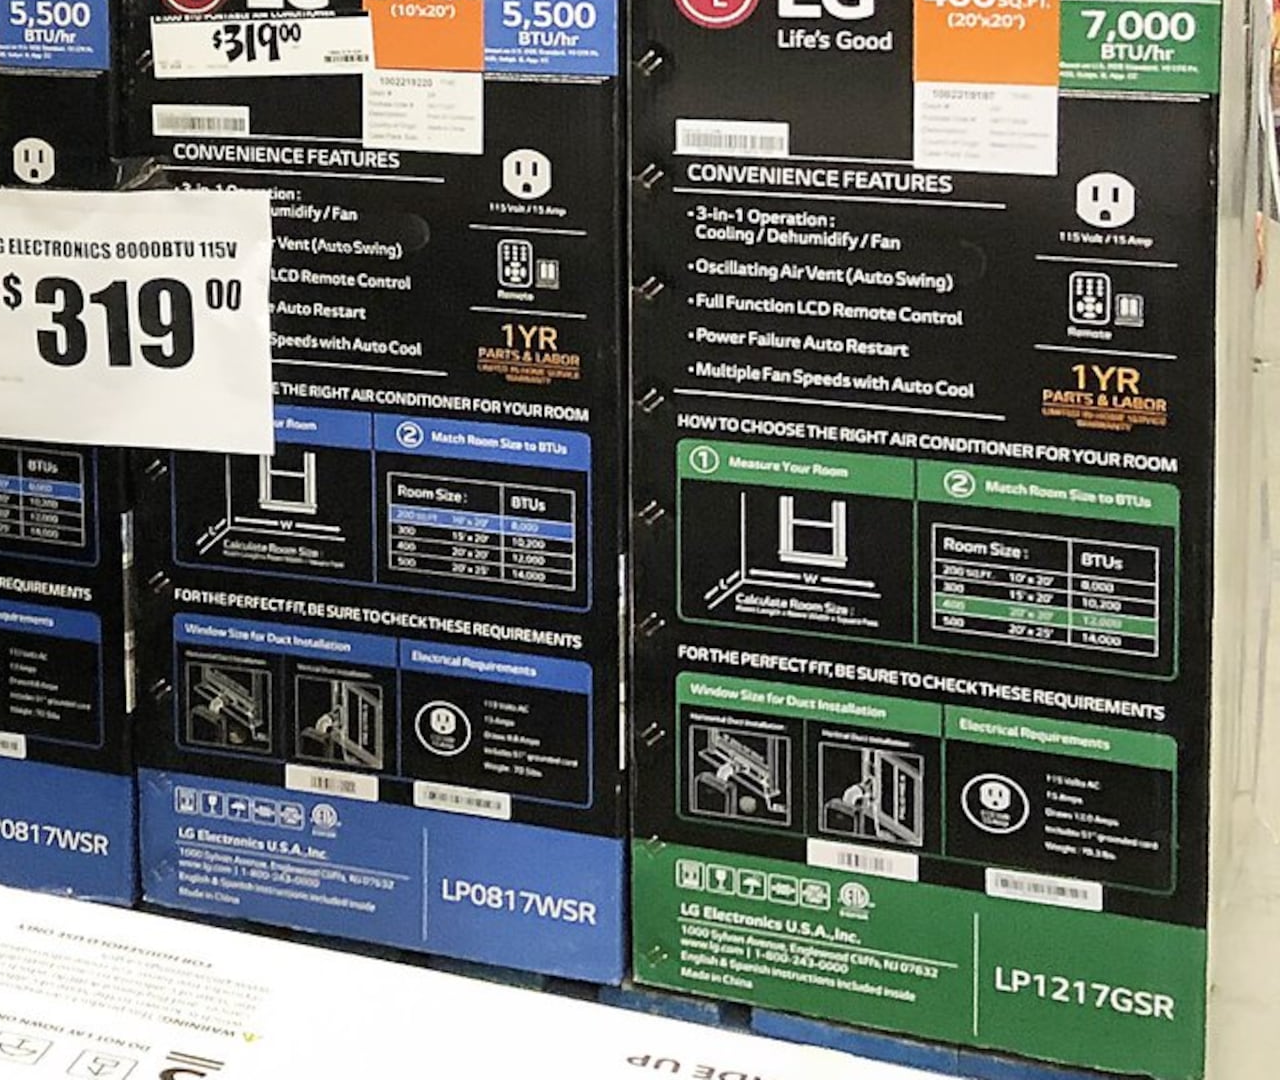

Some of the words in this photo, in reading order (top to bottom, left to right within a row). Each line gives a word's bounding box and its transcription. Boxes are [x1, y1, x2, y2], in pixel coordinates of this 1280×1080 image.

[9, 1, 89, 28] 5,500
[502, 0, 596, 32] 5,500
[1080, 9, 1196, 46] 7,000
[24, 28, 76, 44] BTU/hr
[212, 24, 279, 62] $319
[517, 29, 579, 47] BTU/hr
[777, 29, 831, 50] Life's
[837, 30, 892, 51] Good
[1101, 43, 1175, 62] BTU/hr
[173, 142, 304, 168] CONVENIENCE
[306, 149, 400, 170] FEATURES
[688, 164, 838, 188] CONVENIENCE
[843, 170, 952, 193] FEATURES
[696, 206, 743, 222] 3-in-1
[9, 238, 111, 259] ELECTRONICS
[115, 240, 196, 259] 8000BTU
[200, 241, 237, 259] 115V
[695, 225, 754, 245] Cooling
[768, 229, 859, 251] Dehumidify
[871, 235, 901, 250] Fan
[2, 271, 23, 312] $
[35, 276, 196, 369] 319
[206, 278, 242, 312] 00
[696, 294, 724, 309] Full
[725, 296, 794, 314] Function
[797, 301, 830, 316] LCD
[833, 304, 896, 321] Remote
[898, 308, 963, 326] Control
[1070, 364, 1140, 393] 1YR
[944, 538, 987, 555] Room
[1081, 553, 1123, 571] BTUs
[960, 718, 1018, 738] Electrical
[1020, 726, 1111, 752] Requirements
[442, 879, 597, 924] LP0817WSR
[994, 966, 1175, 1021] LP1217GSR
[627, 1054, 681, 1074] UP
